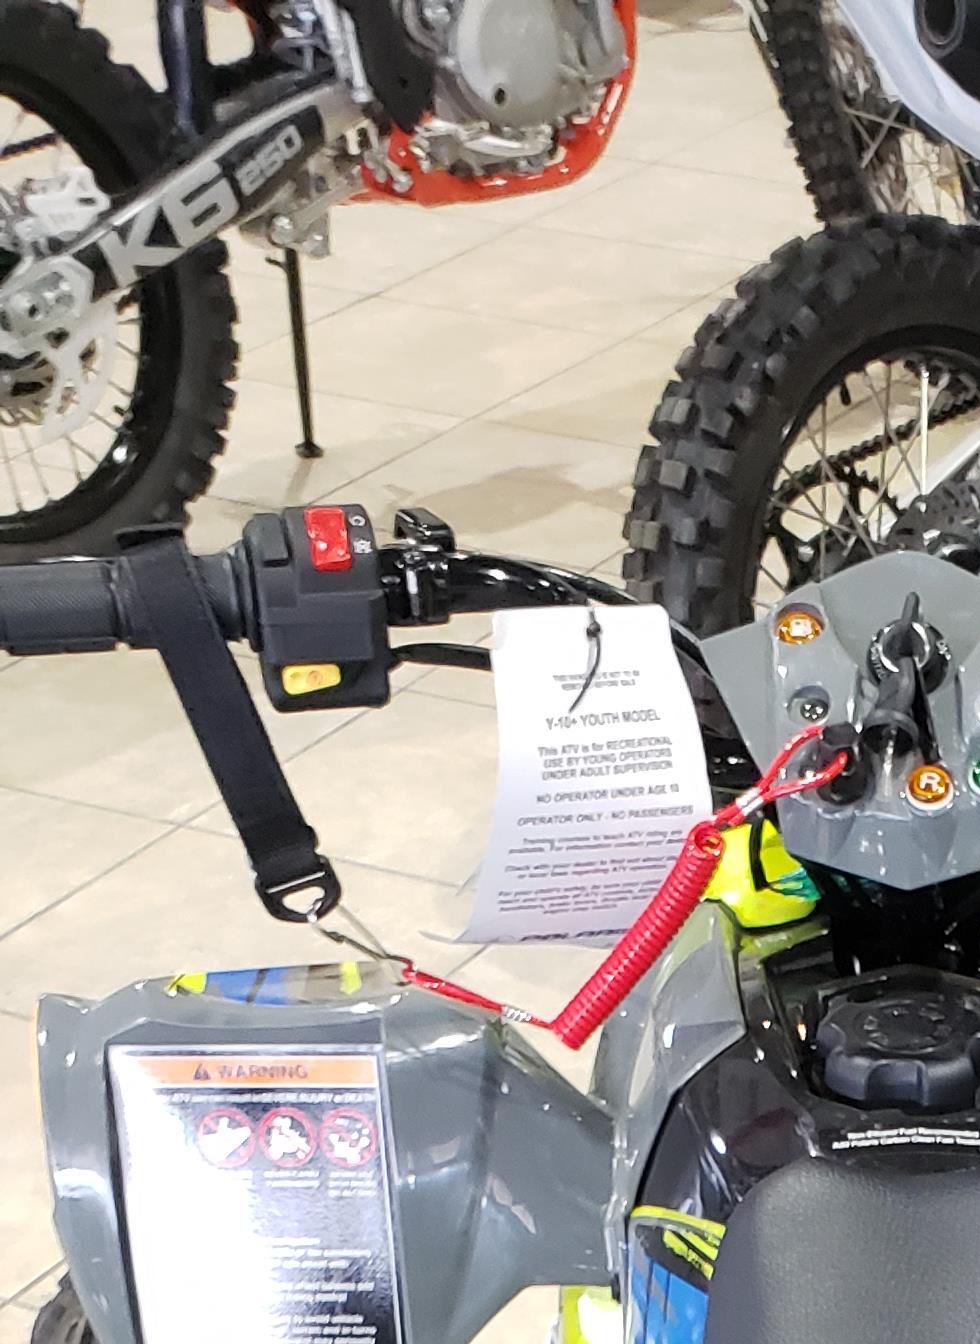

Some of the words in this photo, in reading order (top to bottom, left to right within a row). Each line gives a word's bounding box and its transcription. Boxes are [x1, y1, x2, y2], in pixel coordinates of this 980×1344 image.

[234, 125, 304, 196] 250
[580, 713, 620, 727] YOUTH
[622, 709, 661, 723] MODEL
[538, 746, 558, 757] This
[560, 744, 579, 756] ATV
[582, 744, 589, 755] is
[592, 743, 604, 754] for
[606, 736, 672, 751] RECREATIONAL
[544, 758, 565, 769] USE
[566, 757, 581, 767] BY
[582, 753, 617, 766] YOUNG
[619, 748, 672, 763] OPERATORS
[542, 768, 576, 781] UNDER
[580, 765, 611, 778] ADULT
[613, 760, 673, 775] SUPERVISION
[919, 773, 938, 790] R
[536, 794, 551, 804] NO
[553, 789, 609, 802] OPERATOR
[610, 787, 645, 799] UNDER
[648, 784, 668, 796] AGE
[517, 814, 573, 827] OPERATOR
[576, 812, 603, 824] ONLY
[611, 810, 626, 820] NO
[628, 805, 694, 819] PASSENGERS
[219, 1064, 308, 1080] WARNING
